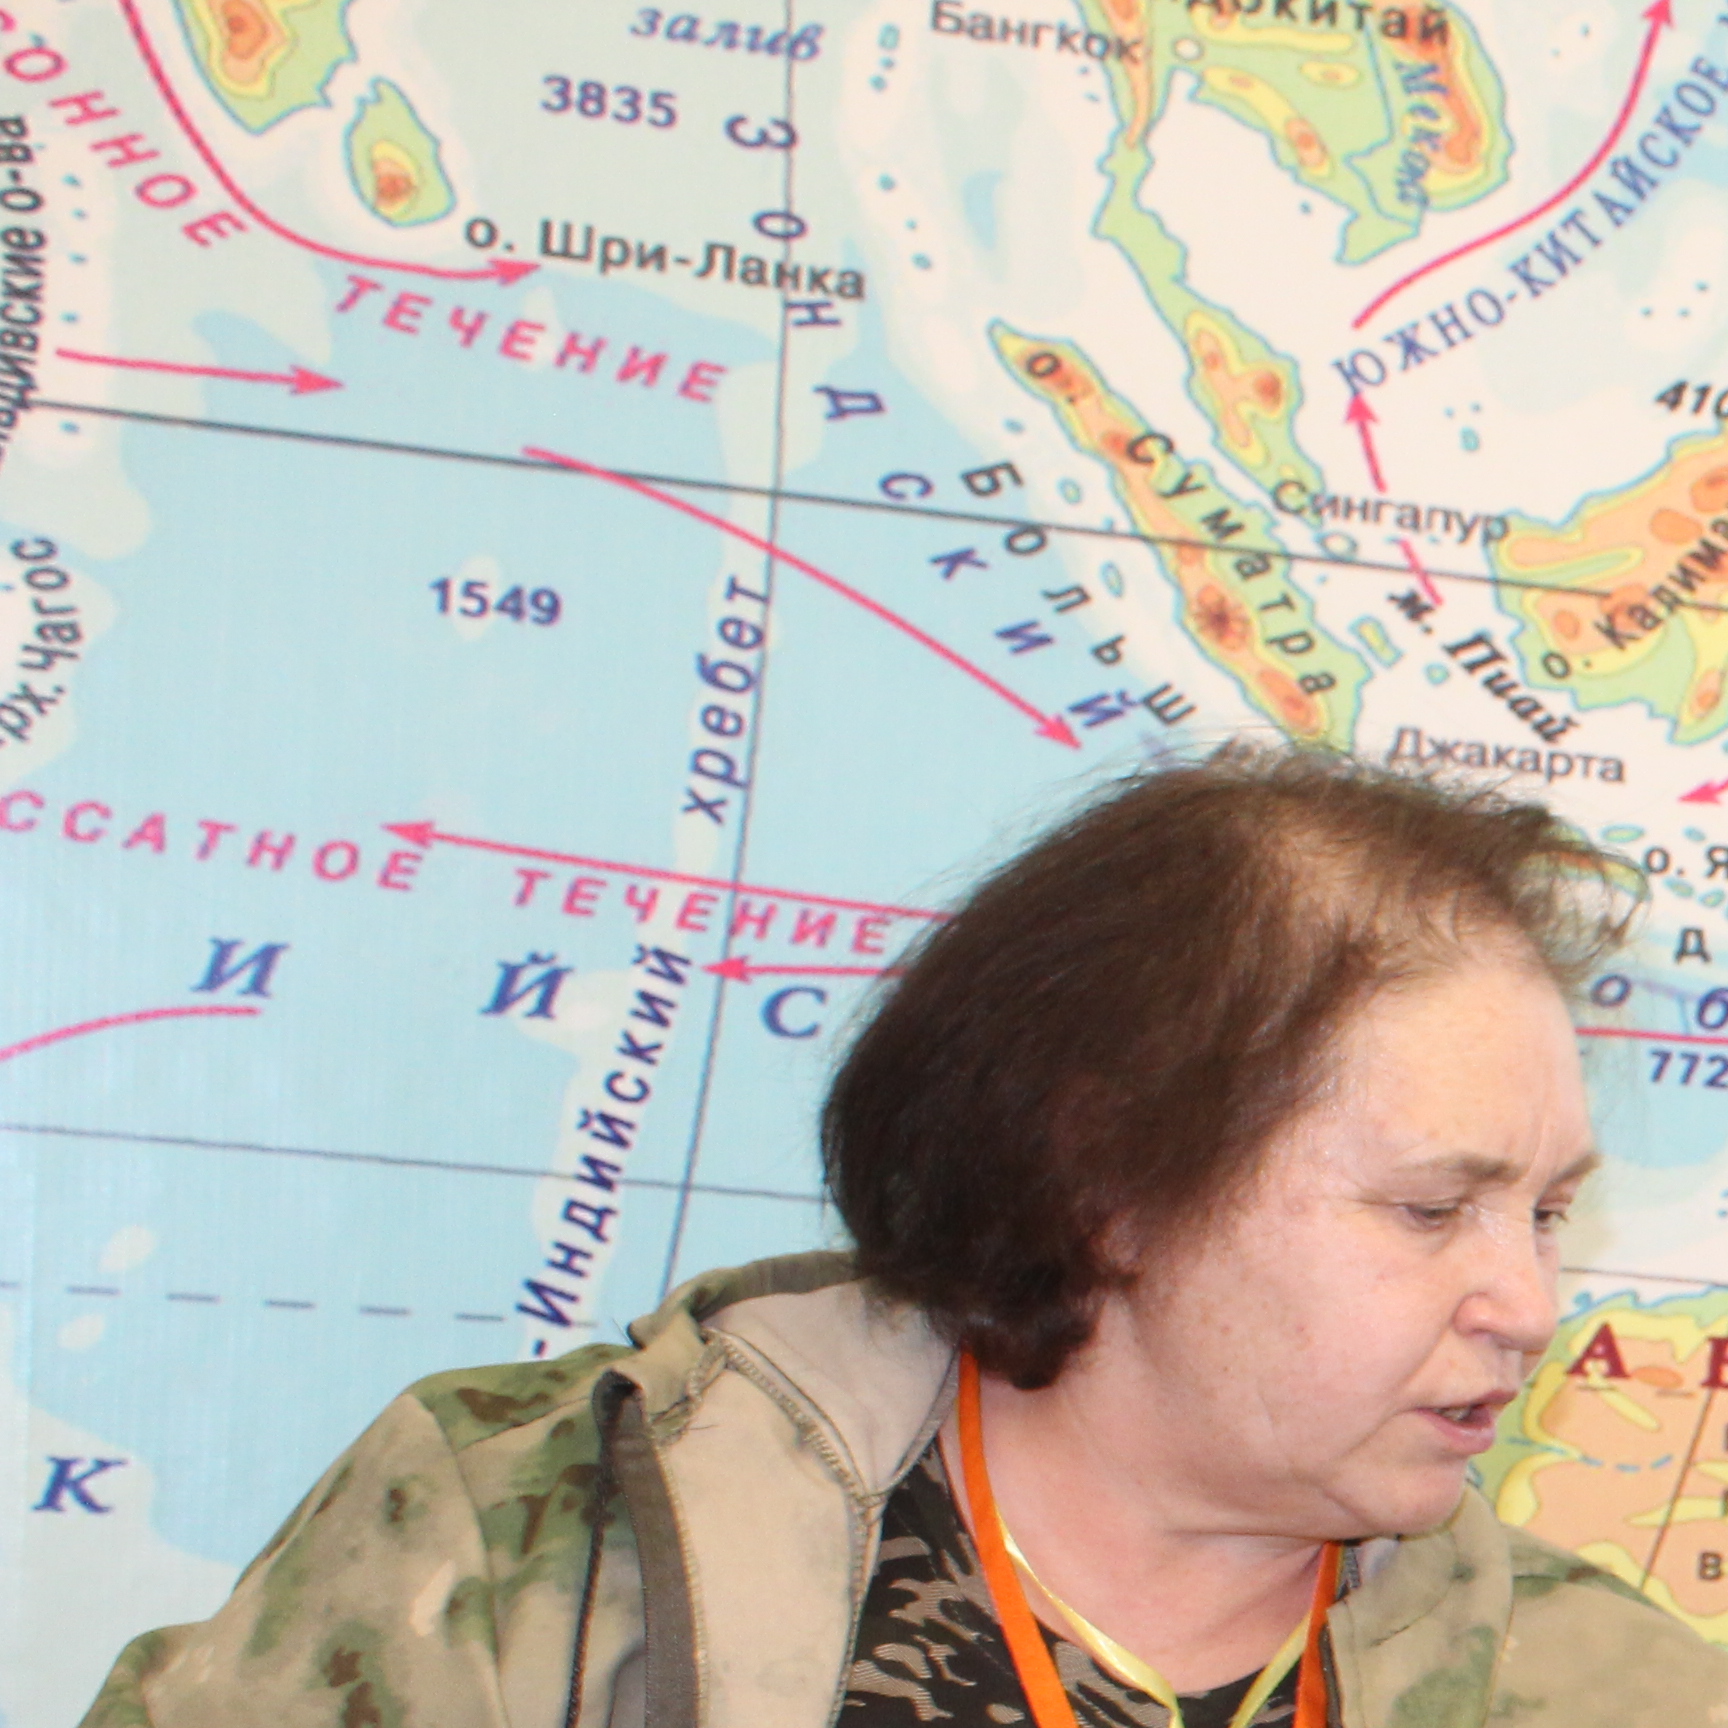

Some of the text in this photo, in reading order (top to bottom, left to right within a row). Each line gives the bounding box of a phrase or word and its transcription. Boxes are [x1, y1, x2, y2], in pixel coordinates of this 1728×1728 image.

[629, 3, 824, 62] залив
[929, 0, 1146, 66] Бангкок
[540, 75, 679, 130] 3835
[0, 5, 728, 403] ОННОЕ ТЕЧЕНИЕ
[464, 215, 867, 304] о. Шри-Ланка
[1272, 477, 1511, 544] Сингапур
[428, 577, 563, 627] 1549
[961, 461, 1198, 728] Больш
[1125, 431, 1338, 696] Суматра
[682, 576, 776, 826] хребет
[1387, 724, 1628, 786] Джакарта
[512, 867, 892, 955] ТЕЧЕНИЕ
